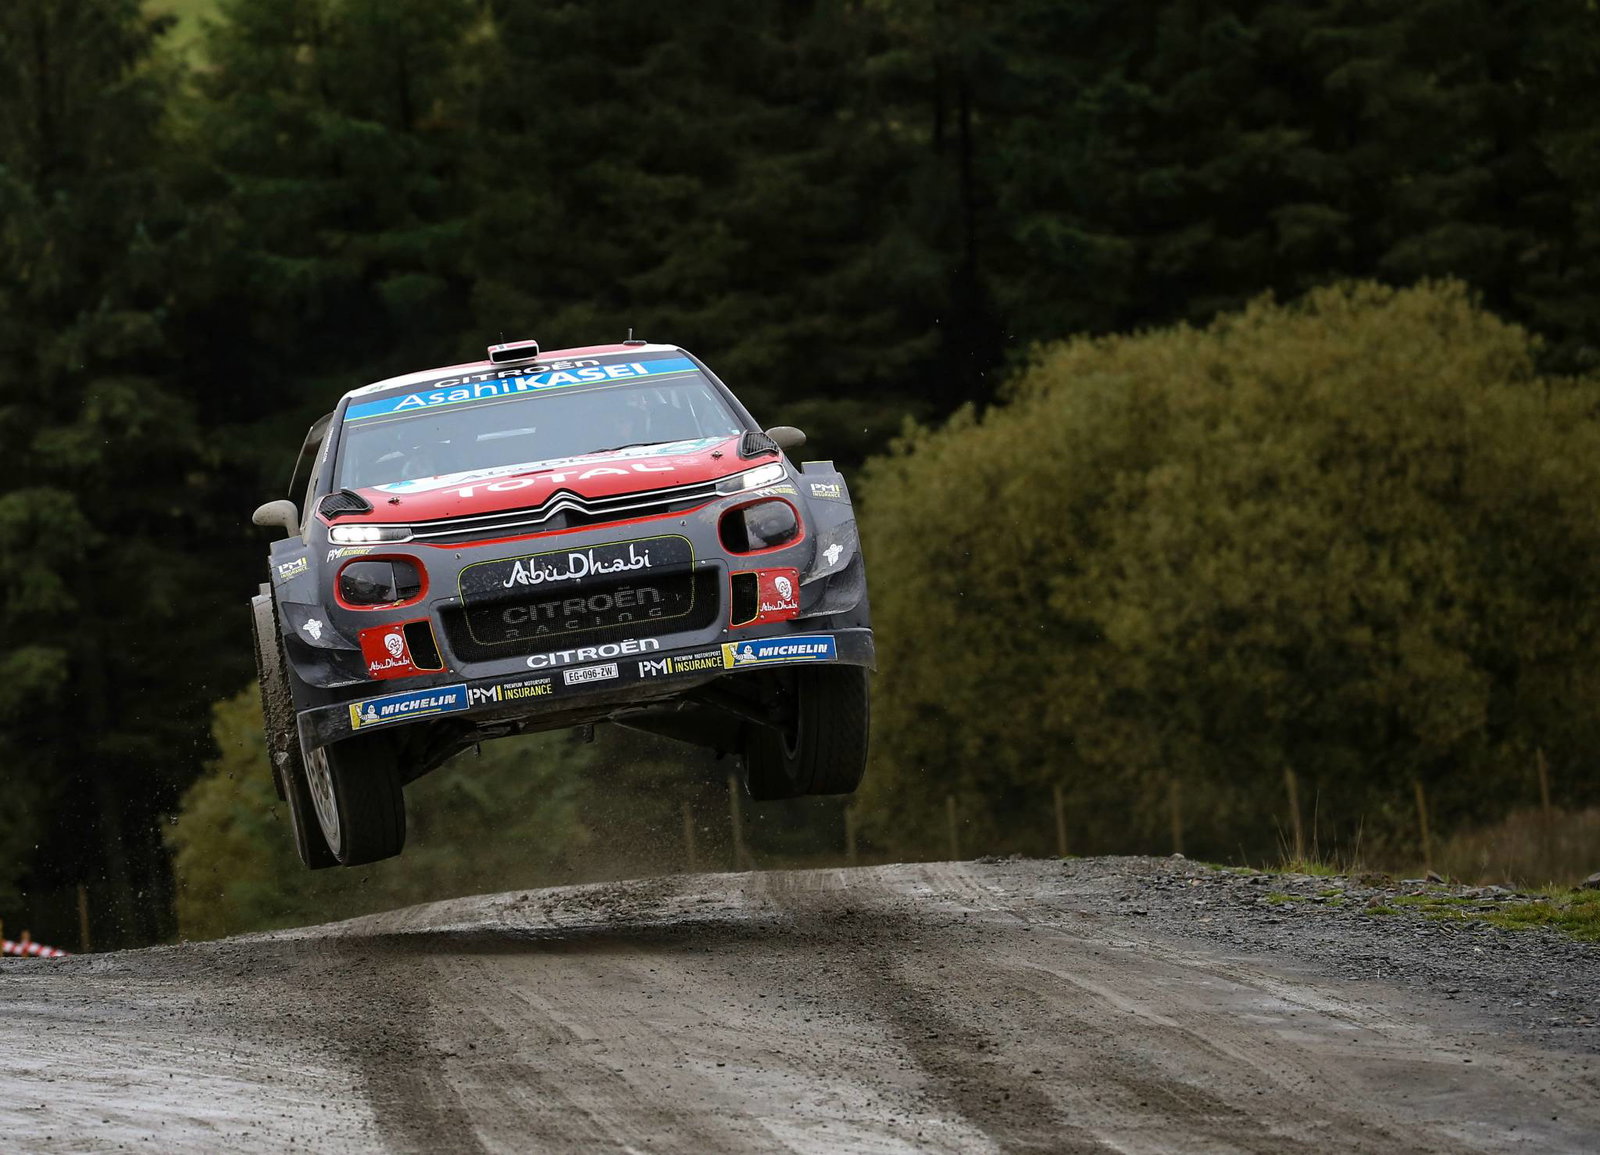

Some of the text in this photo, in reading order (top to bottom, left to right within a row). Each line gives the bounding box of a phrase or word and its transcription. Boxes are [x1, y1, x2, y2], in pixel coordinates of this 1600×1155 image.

[393, 362, 648, 411] AsahiKASEI
[442, 463, 675, 497] TOTAL
[503, 544, 652, 588] Abu Dhabi
[758, 644, 828, 657] MICHELIN
[369, 656, 410, 671] Abu Dhabi
[638, 657, 673, 678] PMI
[675, 656, 723, 673] INSURANCE
[568, 667, 613, 681] EG-096-ZW
[468, 685, 502, 705] PMI
[504, 684, 553, 700] INSURANCE
[380, 694, 457, 715] MICHELIN
